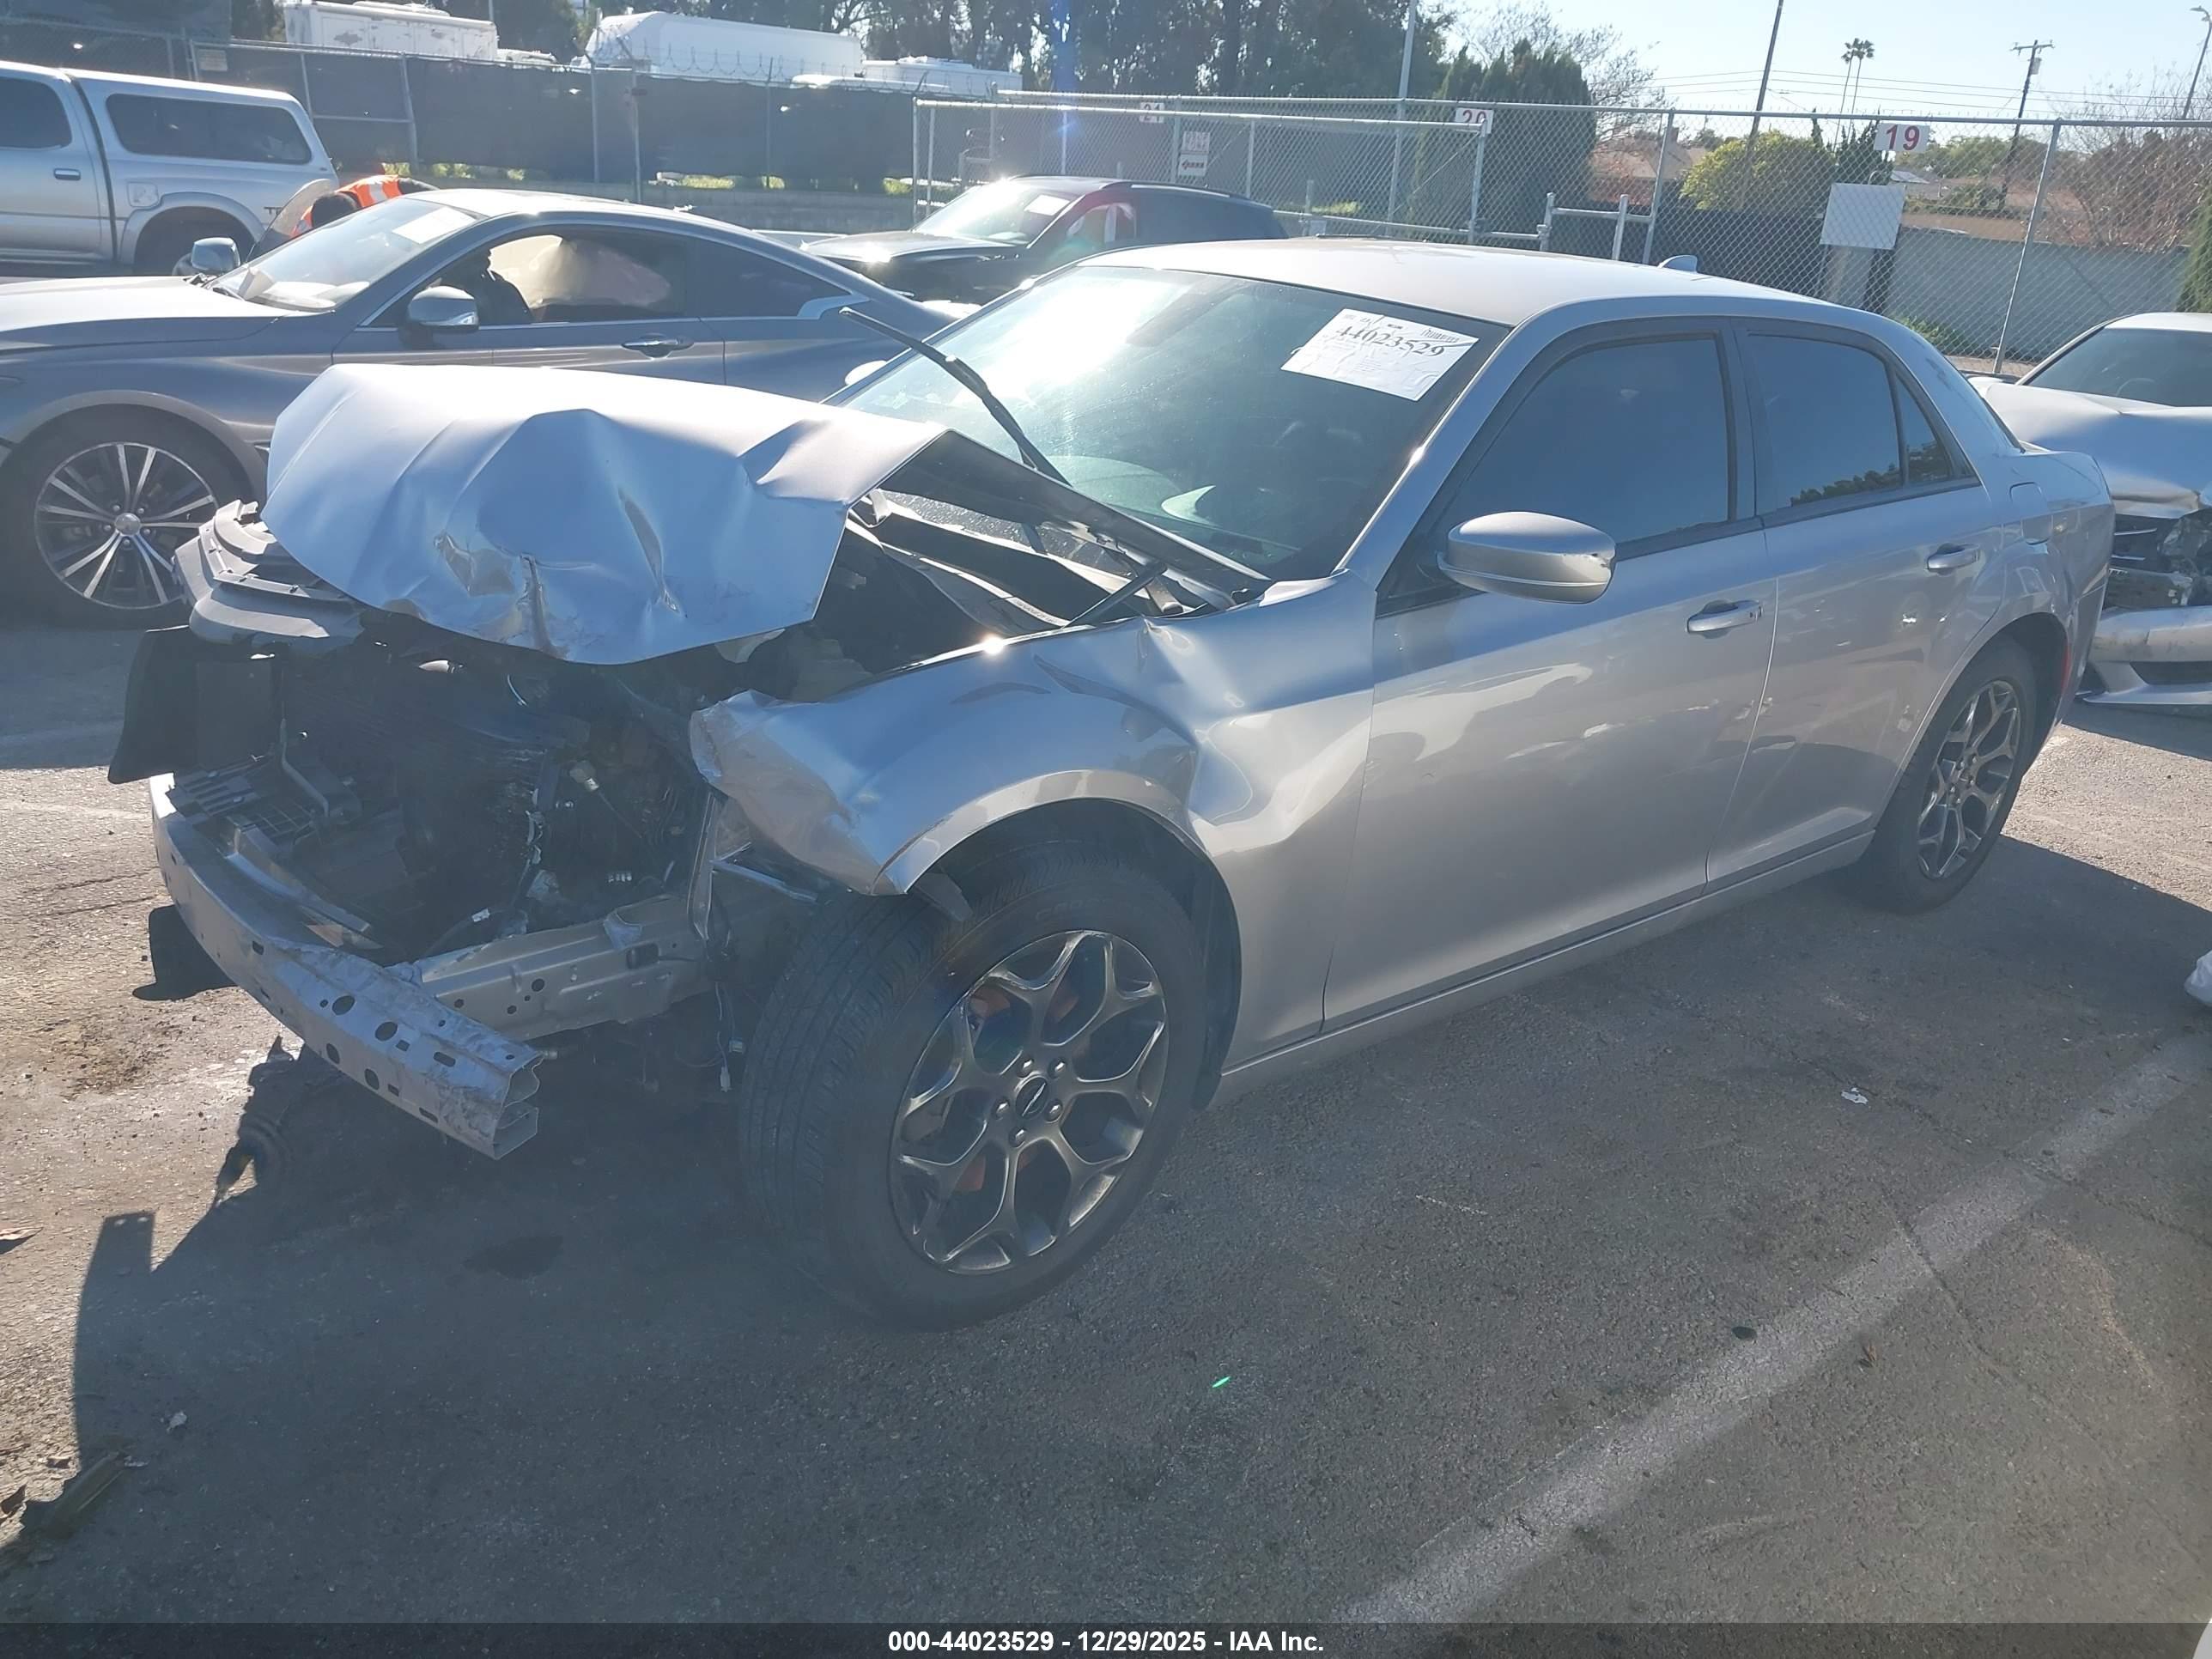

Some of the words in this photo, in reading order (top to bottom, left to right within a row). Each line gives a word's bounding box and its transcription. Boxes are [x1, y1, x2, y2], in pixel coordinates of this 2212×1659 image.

[1462, 109, 1487, 125] 20
[1886, 125, 1920, 150] 19
[1335, 325, 1445, 357] 44023529
